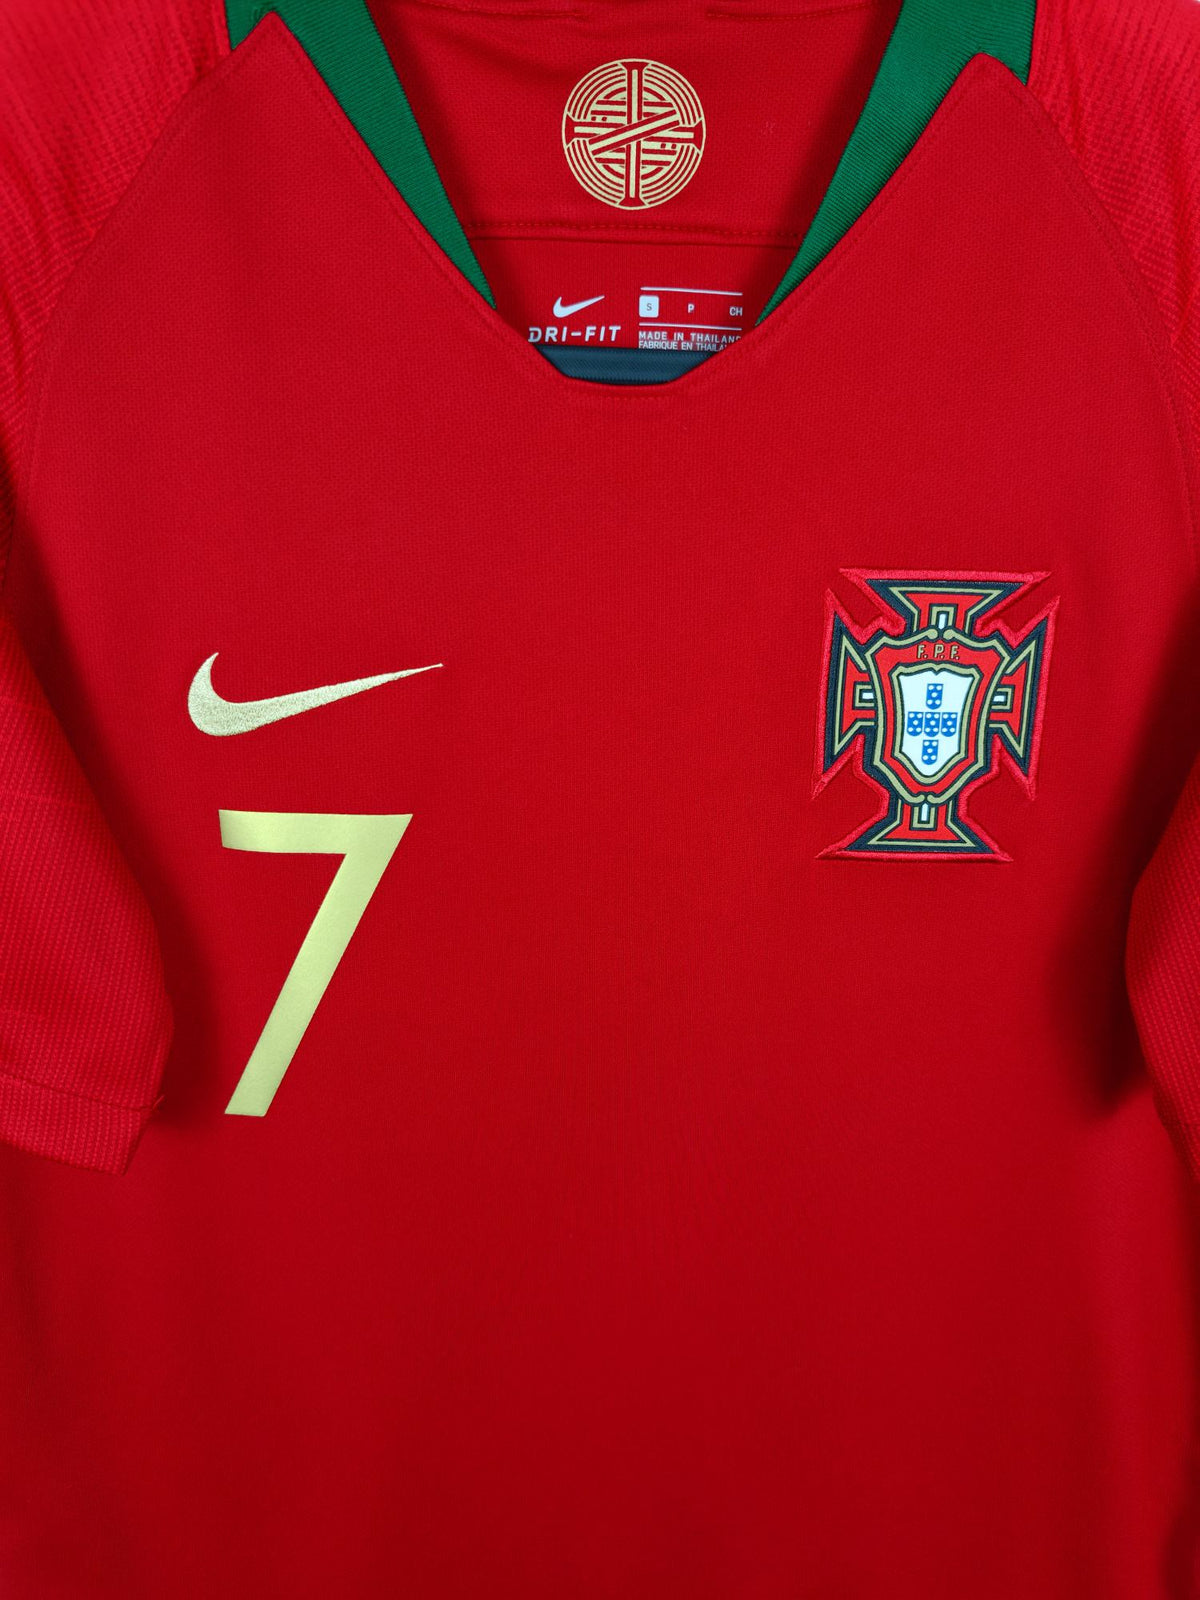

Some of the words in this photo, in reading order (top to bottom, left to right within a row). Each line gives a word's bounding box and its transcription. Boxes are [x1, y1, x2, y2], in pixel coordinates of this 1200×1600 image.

[646, 303, 653, 311] S
[687, 303, 695, 313] P
[729, 306, 743, 316] CH
[527, 325, 622, 342] DRI-FIT
[638, 331, 668, 341] MADE
[673, 332, 684, 342] IN
[638, 340, 678, 350] FABRIQUE
[681, 341, 693, 350] EN
[218, 809, 414, 1117] 7
